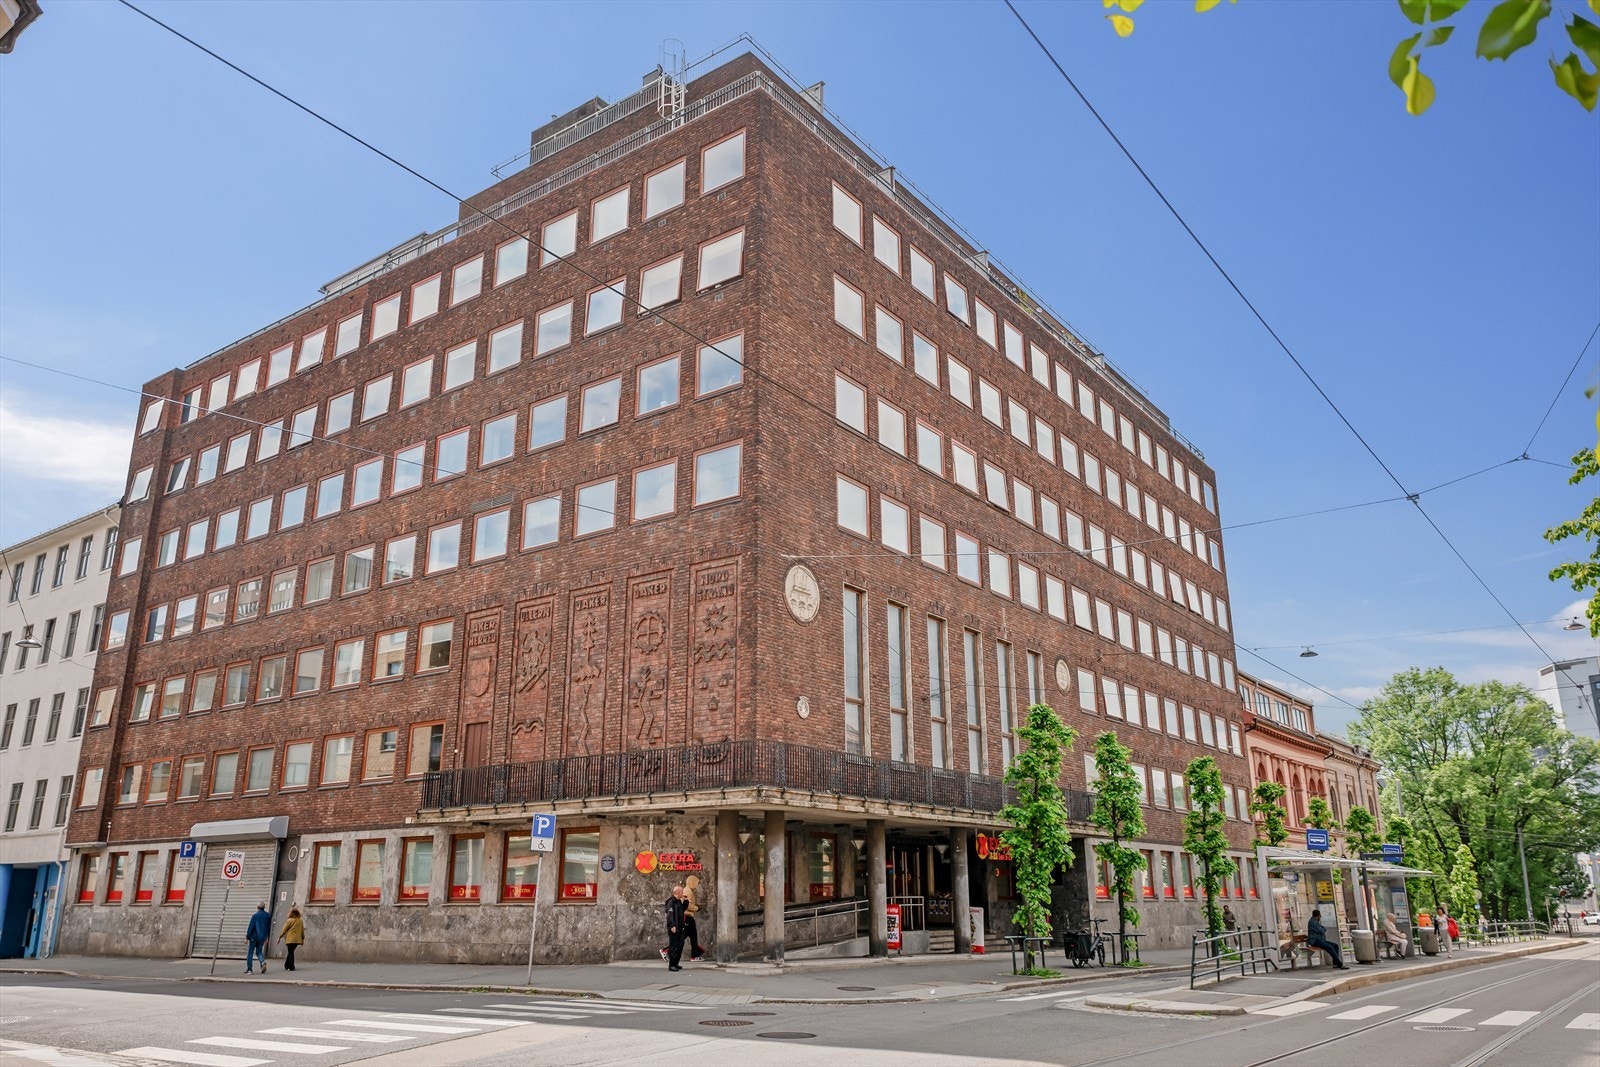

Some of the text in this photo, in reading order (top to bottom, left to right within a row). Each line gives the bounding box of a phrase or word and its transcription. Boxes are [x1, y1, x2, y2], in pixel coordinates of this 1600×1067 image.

[472, 620, 497, 633] AKER
[537, 817, 550, 834] P
[184, 844, 192, 855] P
[659, 853, 694, 862] EXTRA
[227, 865, 238, 874] 30
